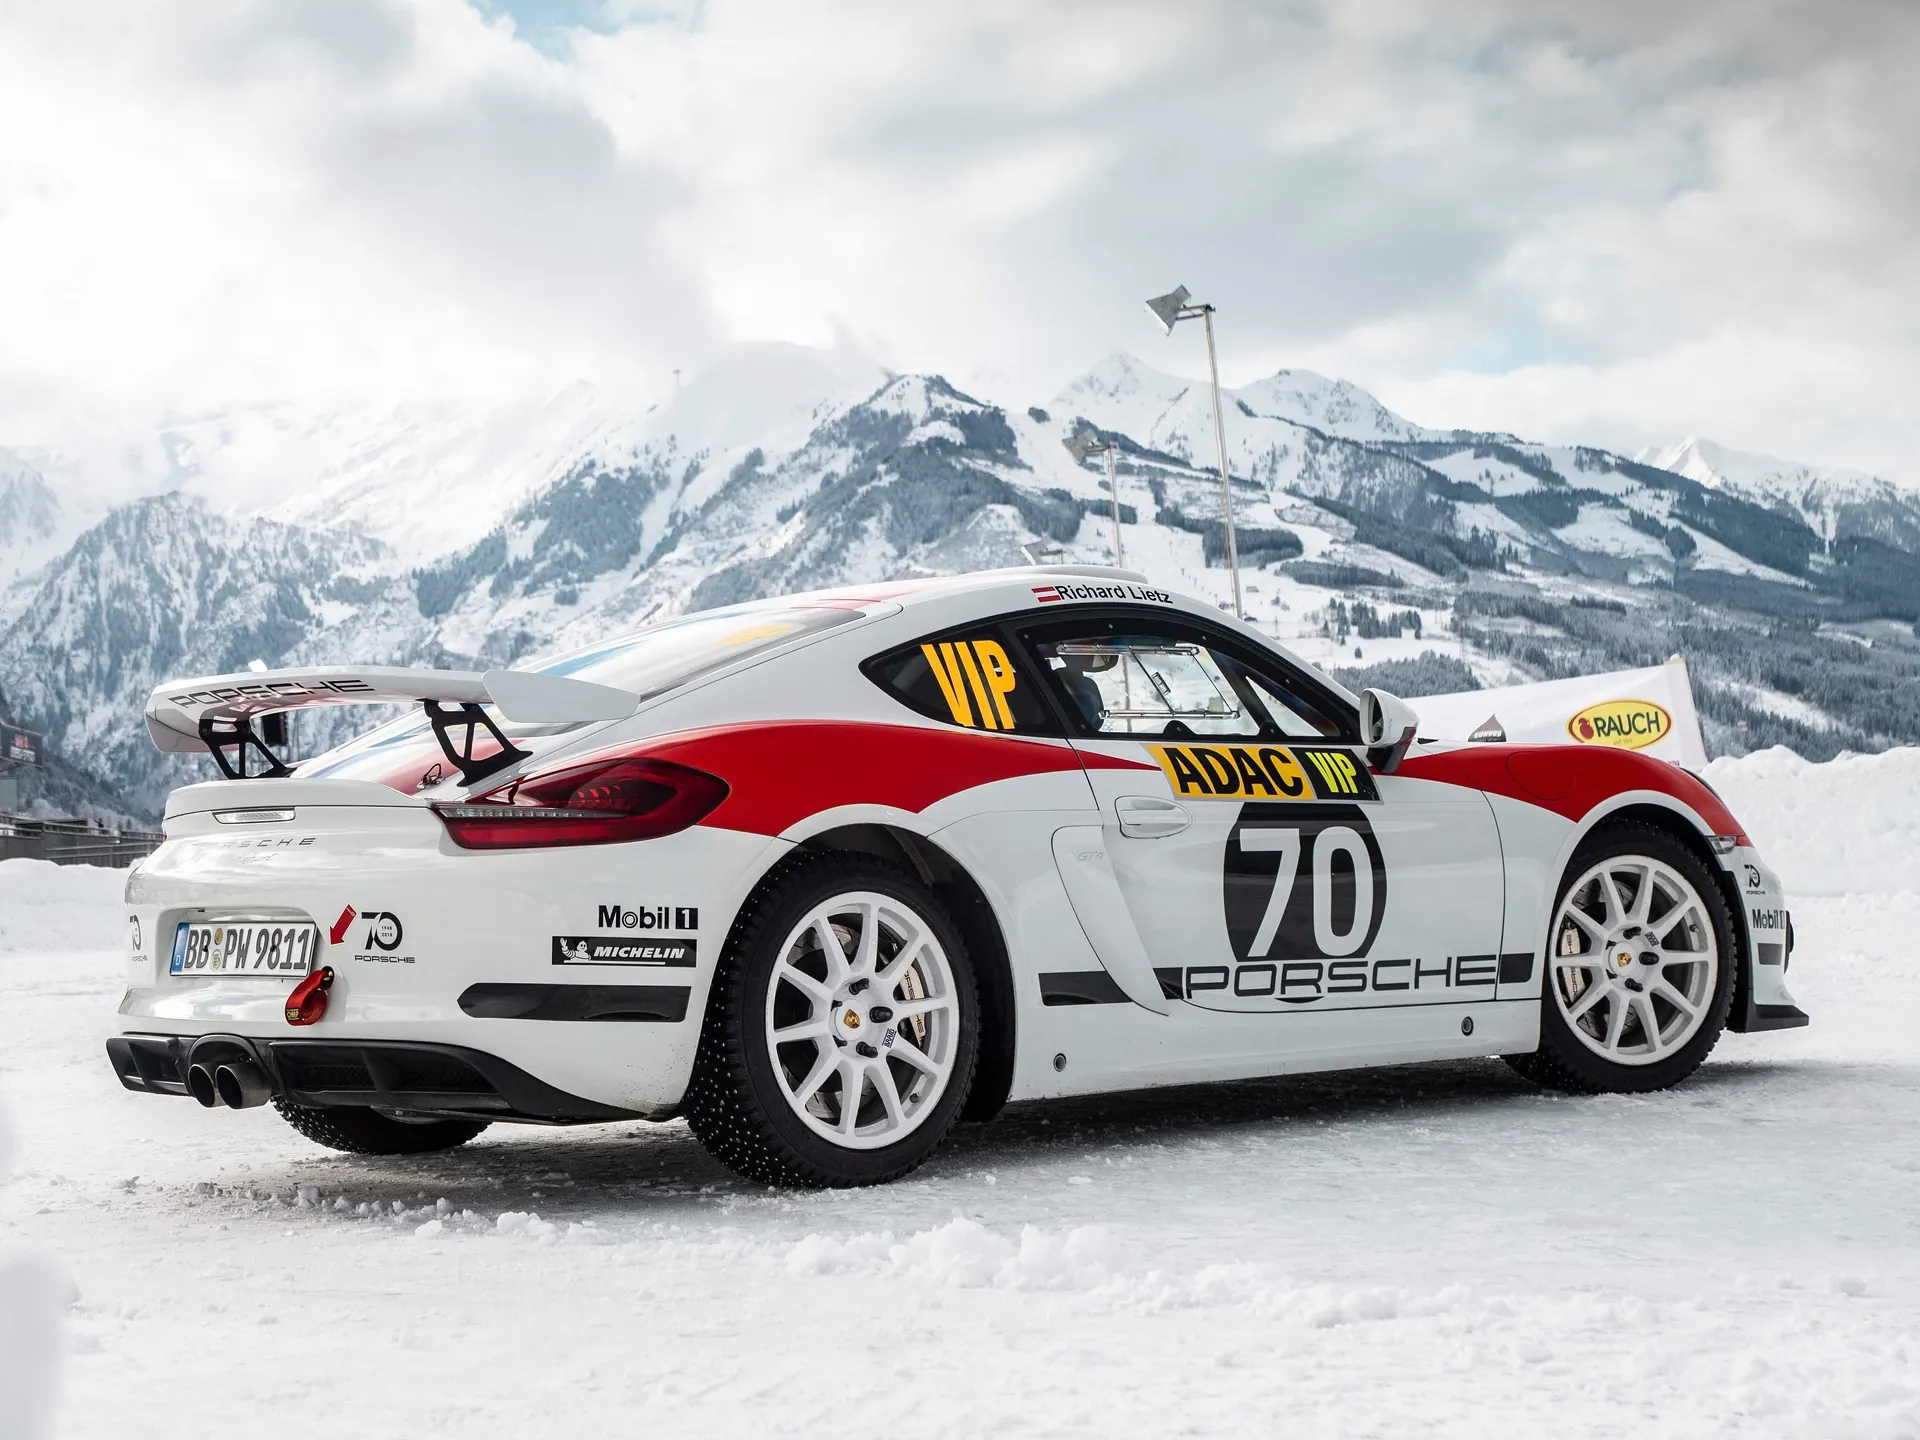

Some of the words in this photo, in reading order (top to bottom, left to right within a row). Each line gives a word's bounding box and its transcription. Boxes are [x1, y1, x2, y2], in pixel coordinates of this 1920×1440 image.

[1054, 584, 1127, 600] Richard
[1127, 586, 1174, 604] Lietz
[168, 680, 376, 708] PORSCHE
[920, 640, 1016, 730] VIP
[1593, 711, 1660, 738] RAUCH
[1162, 747, 1304, 797] ADAC
[1305, 752, 1359, 794] VIP
[1239, 826, 1374, 959] 70
[361, 911, 403, 951] 70
[598, 905, 670, 930] Mobil
[1752, 908, 1779, 930] Mobil
[184, 929, 212, 969] BB
[222, 928, 252, 969] PW
[253, 928, 310, 970] 9811
[354, 954, 416, 964] PORSCHE
[593, 946, 685, 959] MICHELIN
[1185, 954, 1497, 1000] PORSCHE
[286, 1010, 299, 1019] OMP
